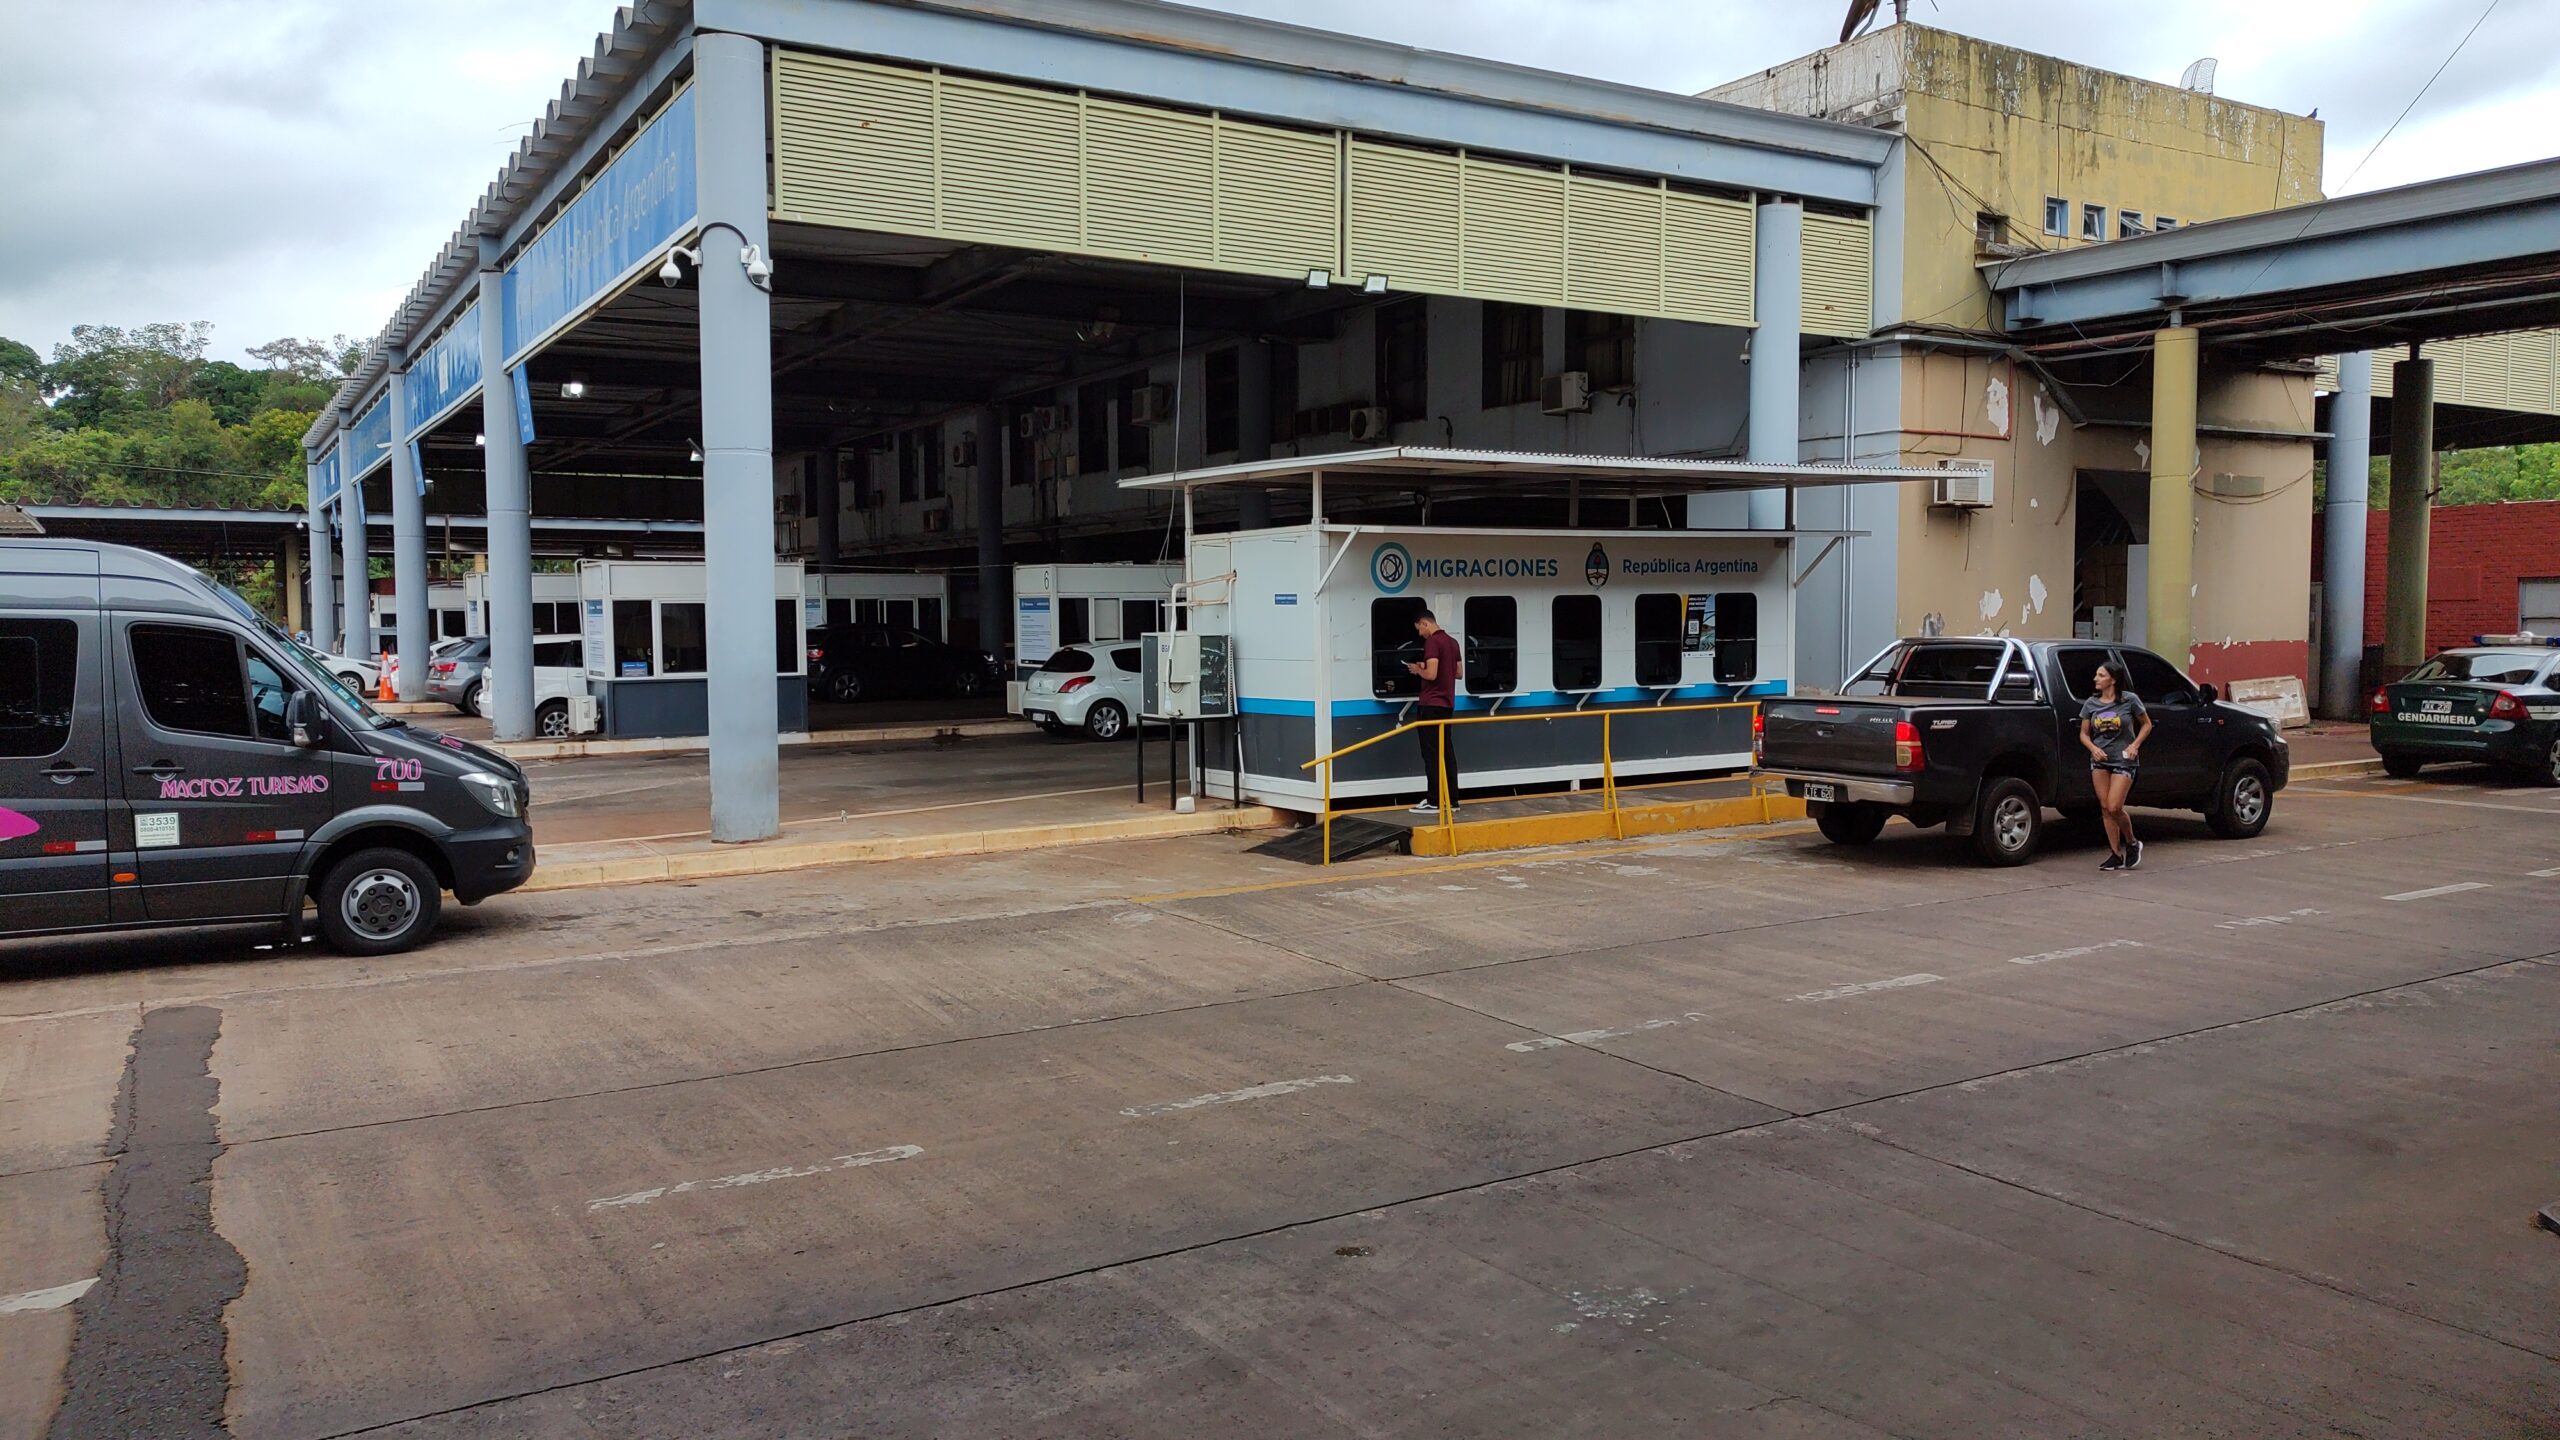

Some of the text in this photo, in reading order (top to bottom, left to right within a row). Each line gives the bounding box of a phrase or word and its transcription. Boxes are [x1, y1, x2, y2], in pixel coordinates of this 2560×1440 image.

[1416, 559, 1558, 577] MIGRACIONES
[1623, 558, 1758, 576] República Argentina
[1044, 571, 1049, 590] 6
[2398, 712, 2476, 725] GENDARMERIA
[375, 757, 422, 780] 700
[247, 775, 329, 796] TURISMO
[149, 816, 176, 826] 3539
